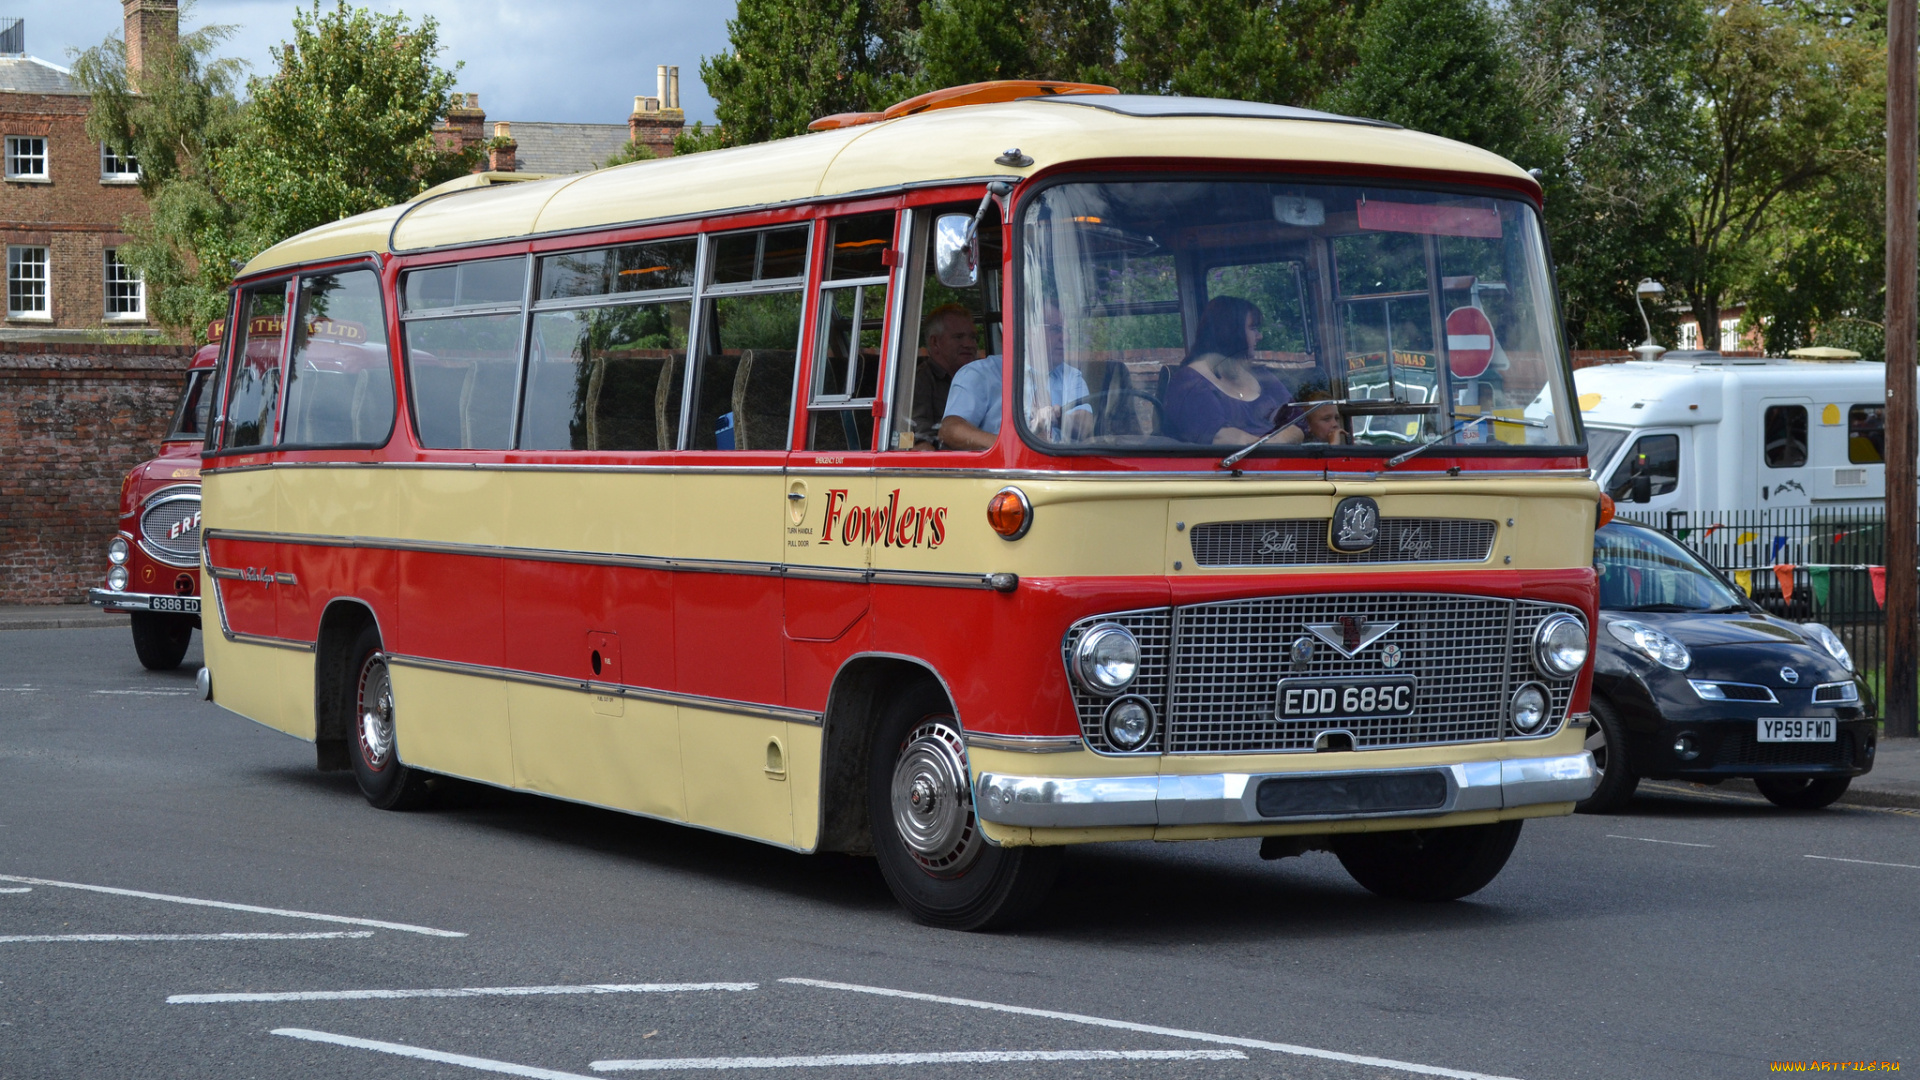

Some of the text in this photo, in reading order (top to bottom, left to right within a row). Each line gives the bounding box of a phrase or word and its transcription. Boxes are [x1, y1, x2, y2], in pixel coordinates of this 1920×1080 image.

[255, 319, 322, 334] THOAS
[1380, 351, 1426, 367] TMAS
[818, 488, 948, 549] Fowlers
[1258, 527, 1432, 558] Bella Vega
[145, 569, 151, 579] 7
[153, 597, 199, 611] 6386 ED
[1284, 685, 1411, 715] EDD 685C
[1764, 720, 1831, 738] YP59 FWD
